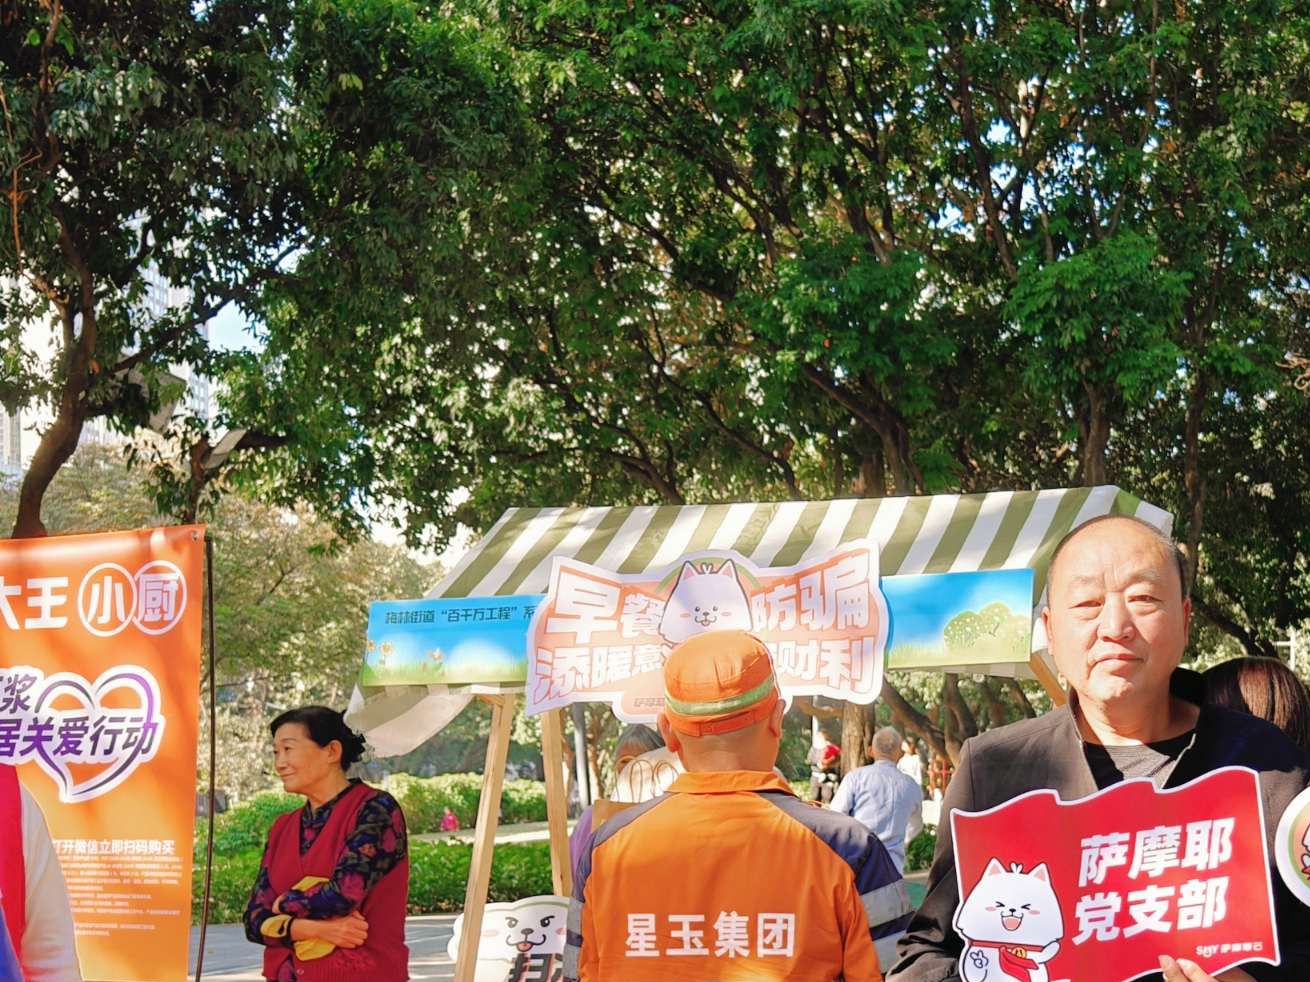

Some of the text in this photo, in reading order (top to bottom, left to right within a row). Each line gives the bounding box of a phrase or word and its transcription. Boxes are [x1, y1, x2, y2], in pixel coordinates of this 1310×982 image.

[751, 552, 869, 634] 防骗
[0, 674, 37, 713] 浆
[767, 636, 874, 694] 财利
[1078, 817, 1236, 888] 萨摩耶
[624, 911, 796, 958] 星玉集团
[1071, 876, 1230, 946] 党支部
